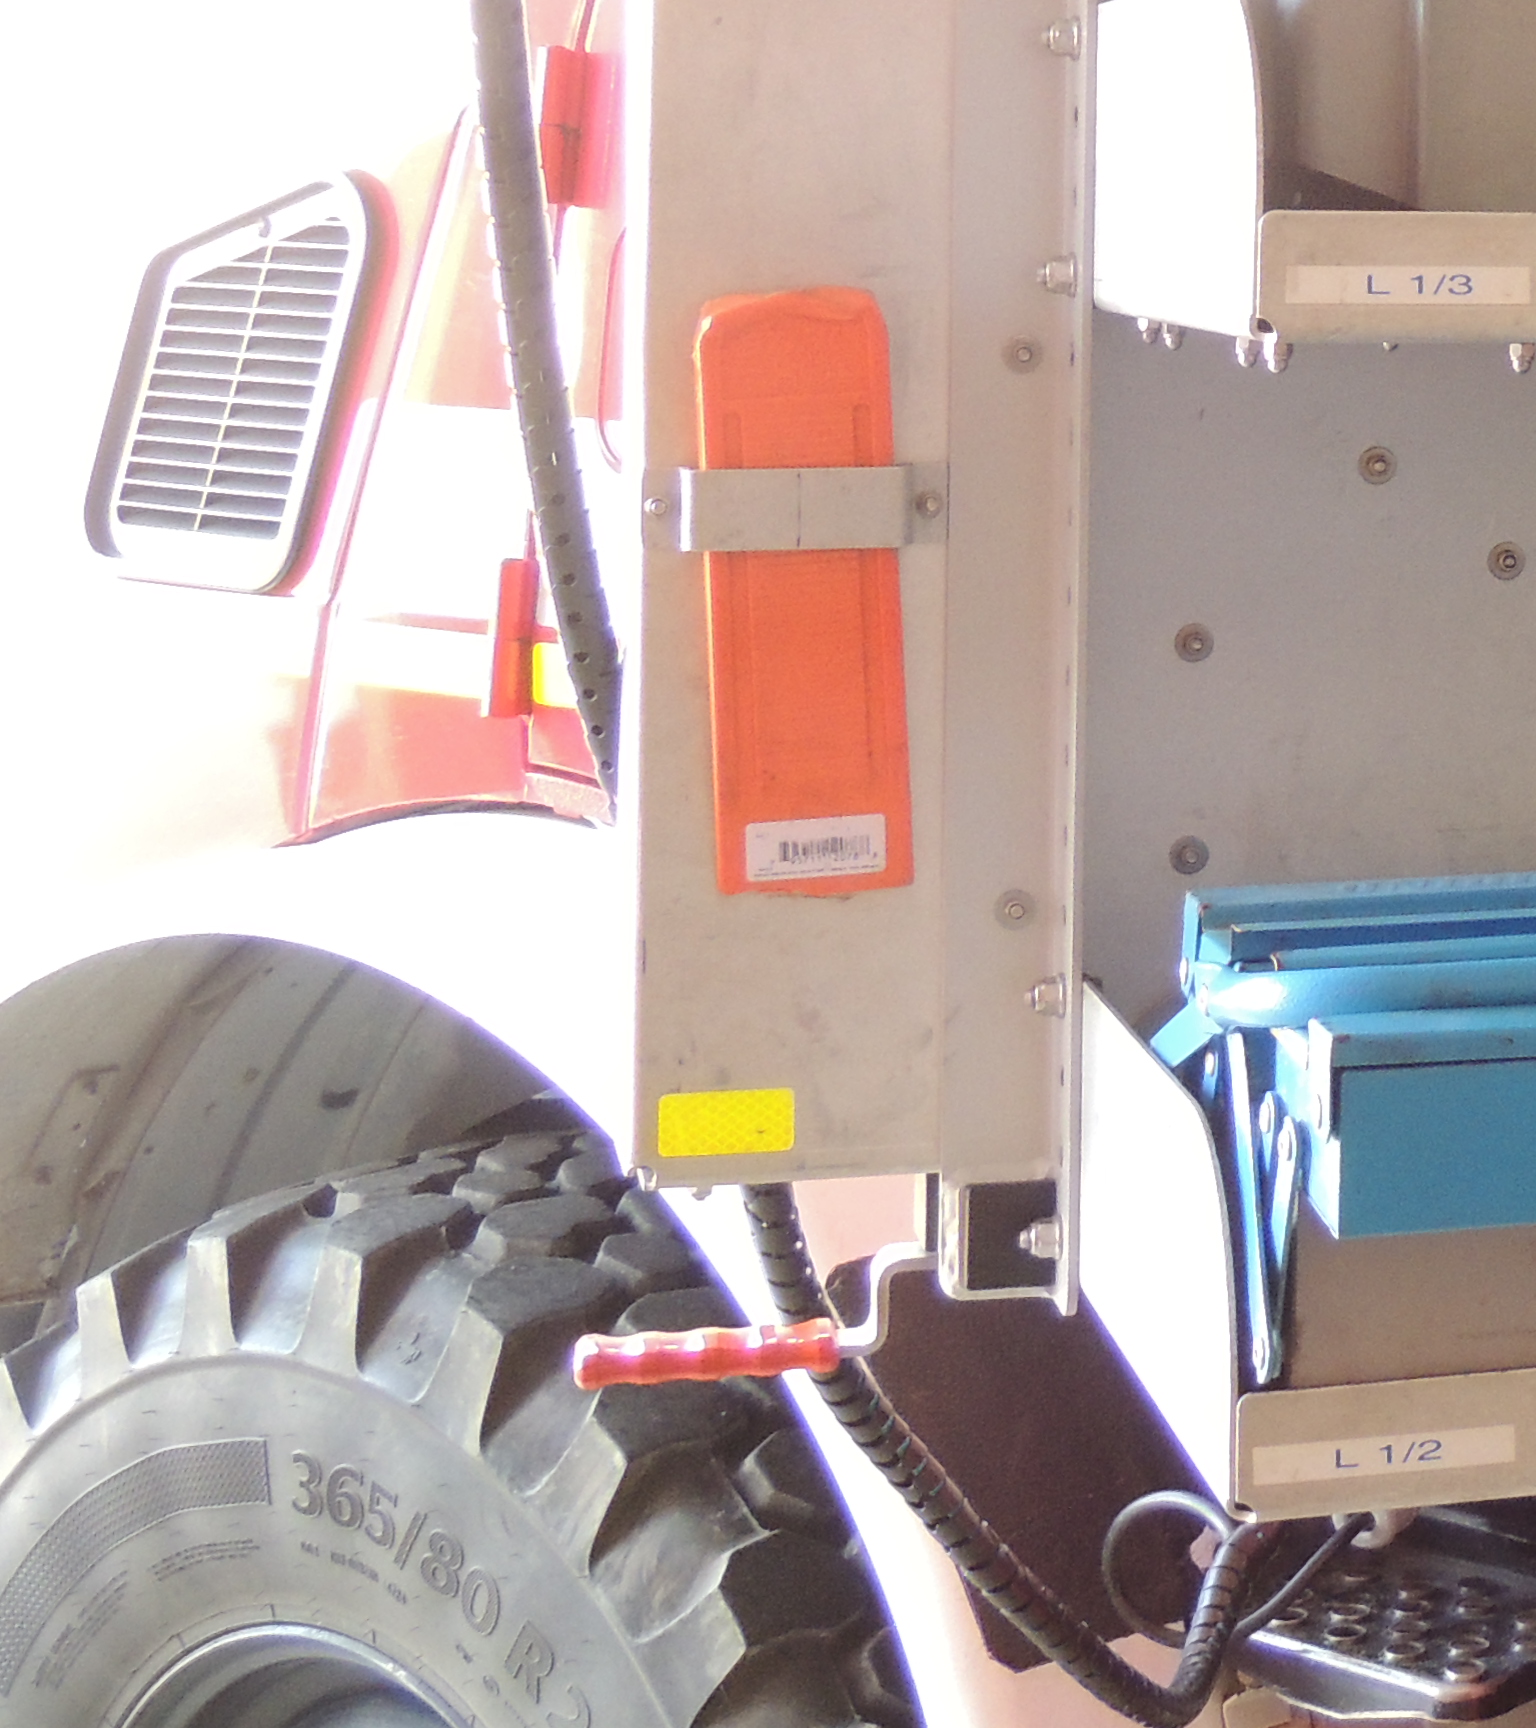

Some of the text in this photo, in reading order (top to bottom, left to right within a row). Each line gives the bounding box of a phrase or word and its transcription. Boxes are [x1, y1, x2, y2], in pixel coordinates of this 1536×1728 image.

[1366, 273, 1473, 295] L 1/3
[1335, 1438, 1443, 1469] L 1/2
[291, 1450, 501, 1636] 365/80
